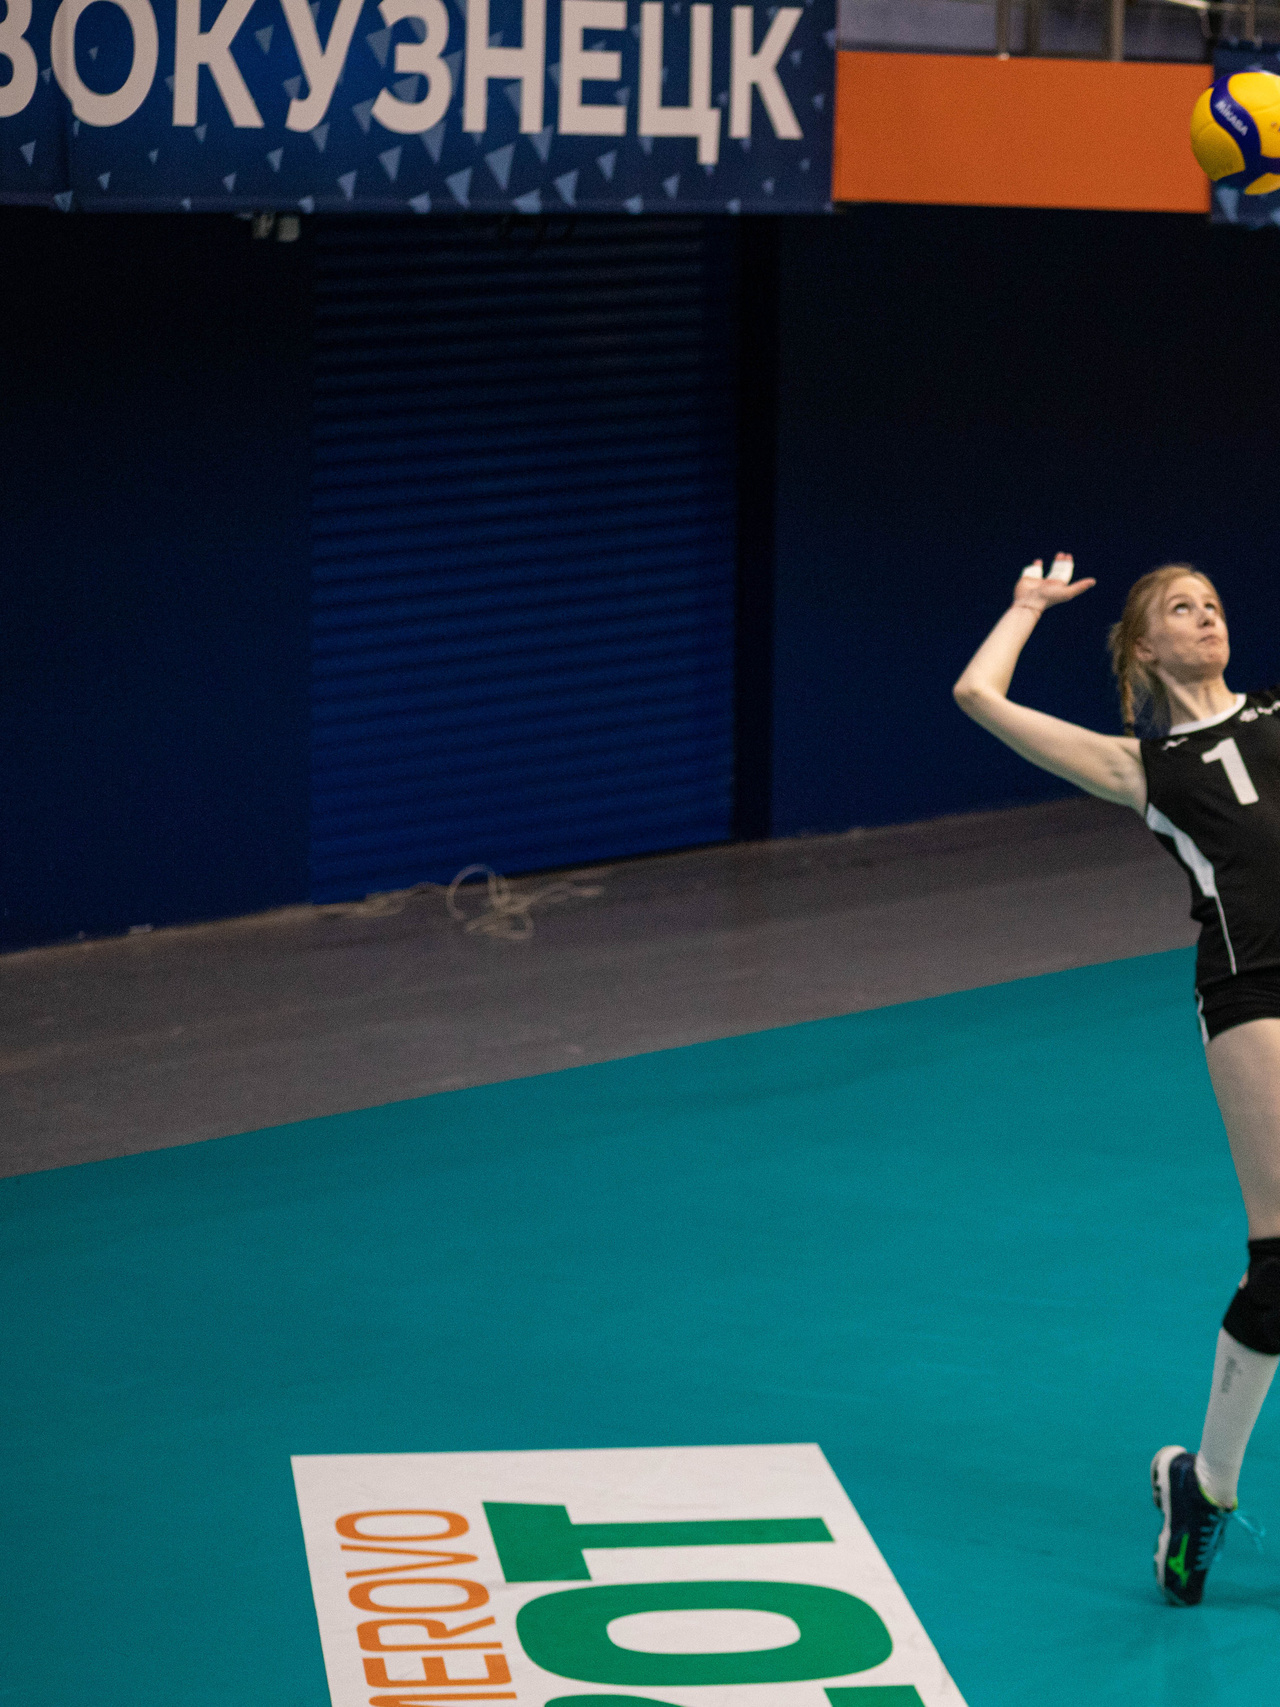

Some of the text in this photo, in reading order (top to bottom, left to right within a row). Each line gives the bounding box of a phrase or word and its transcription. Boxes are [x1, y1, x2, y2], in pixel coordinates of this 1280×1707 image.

[1201, 737, 1259, 805] 1
[335, 1509, 517, 1707] EROVO
[482, 1501, 926, 1707] OT
